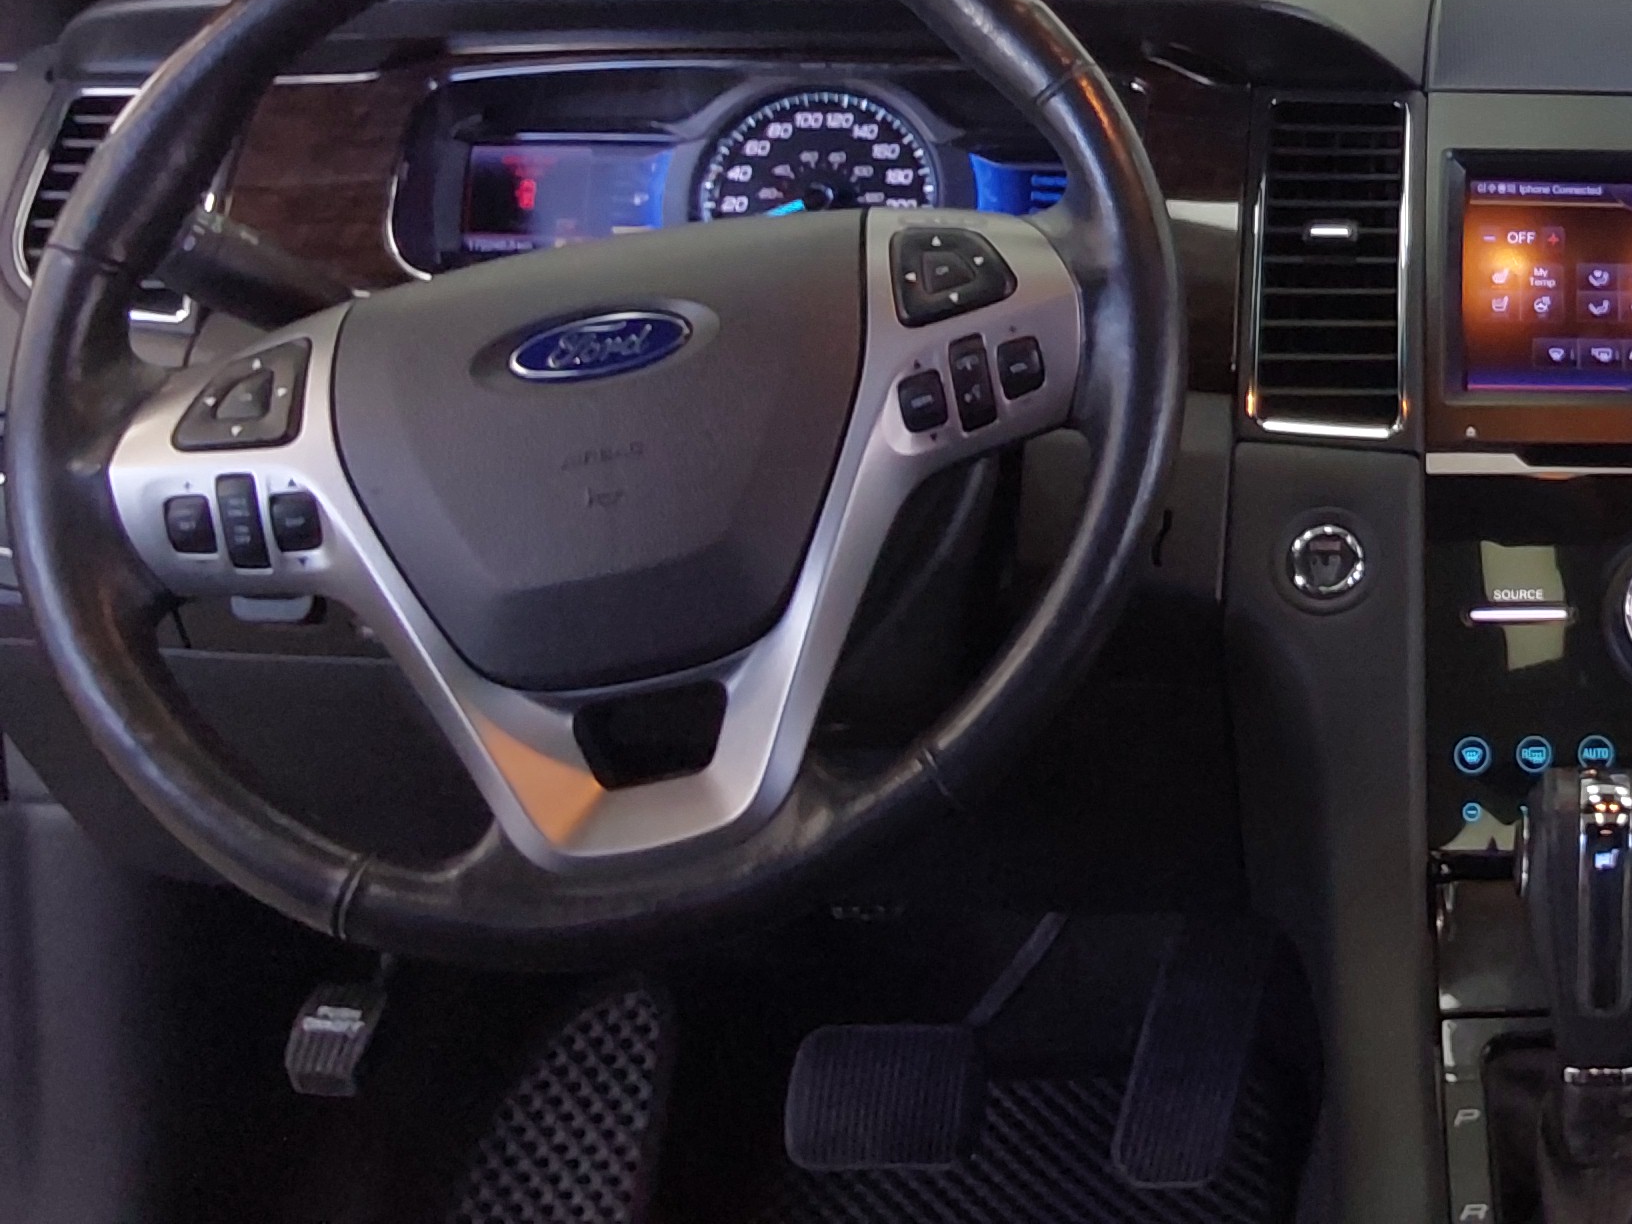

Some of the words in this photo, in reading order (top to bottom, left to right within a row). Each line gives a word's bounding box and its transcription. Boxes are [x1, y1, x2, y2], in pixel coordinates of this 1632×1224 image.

[794, 111, 823, 129] 100
[726, 164, 753, 182] 40
[1552, 185, 1603, 197] Connected
[1507, 231, 1536, 245] OFF
[1533, 267, 1549, 278] My
[1530, 277, 1556, 289] Temp
[547, 321, 653, 368] Ford
[1493, 587, 1544, 601] SOURCE
[1582, 747, 1609, 760] AUTO
[1453, 1108, 1481, 1128] P
[1460, 1203, 1489, 1221] R
